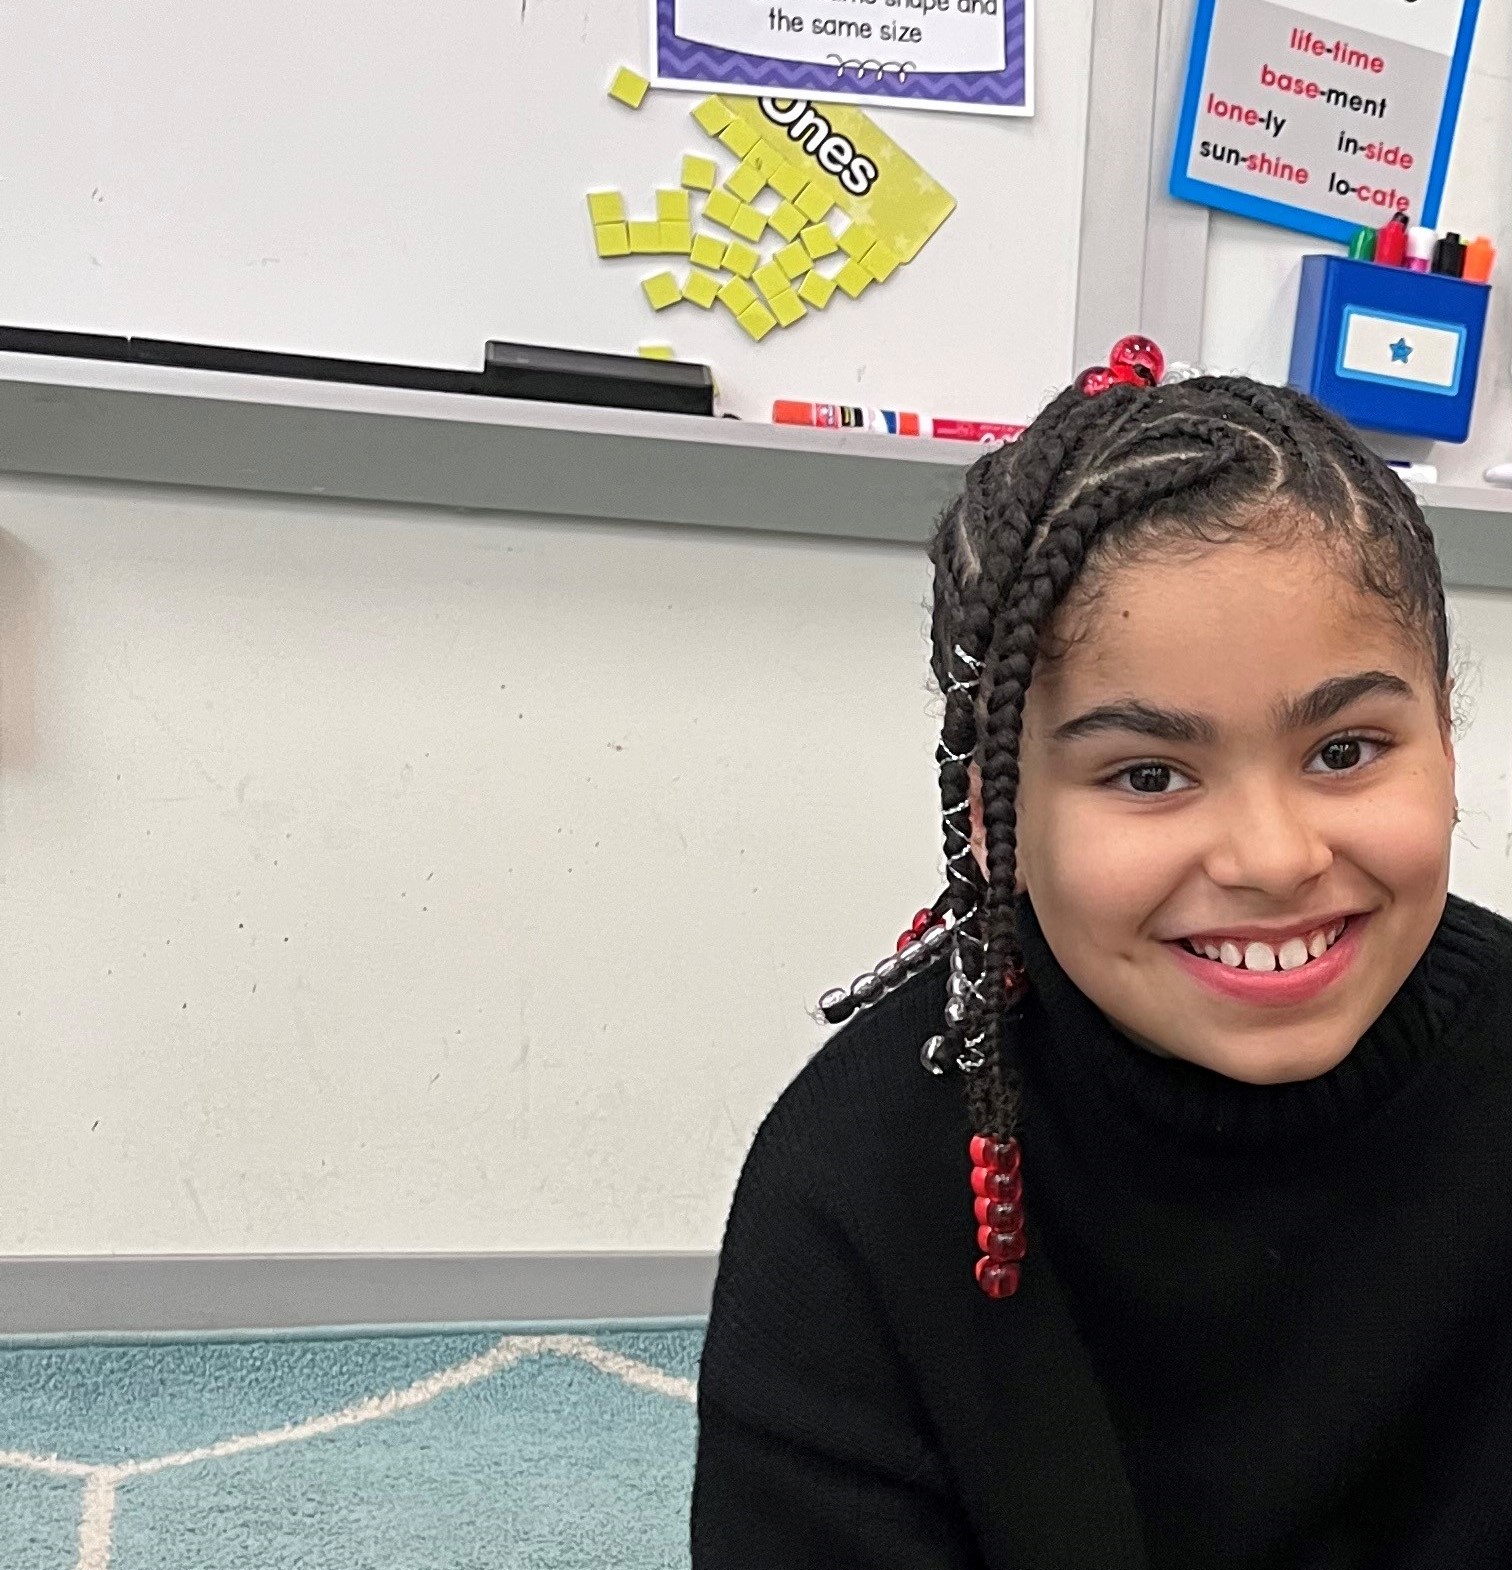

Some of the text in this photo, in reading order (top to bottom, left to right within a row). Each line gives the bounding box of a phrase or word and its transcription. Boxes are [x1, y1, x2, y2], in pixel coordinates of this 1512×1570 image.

[768, 9, 923, 43] the same size
[1289, 27, 1385, 74] life-time
[1259, 63, 1388, 119] base-ment
[1206, 92, 1287, 138] lone-ly
[758, 97, 879, 197] Ones
[1199, 140, 1310, 185] sun-shine
[1337, 130, 1414, 170] in-side
[1328, 171, 1411, 213] lo-cate
